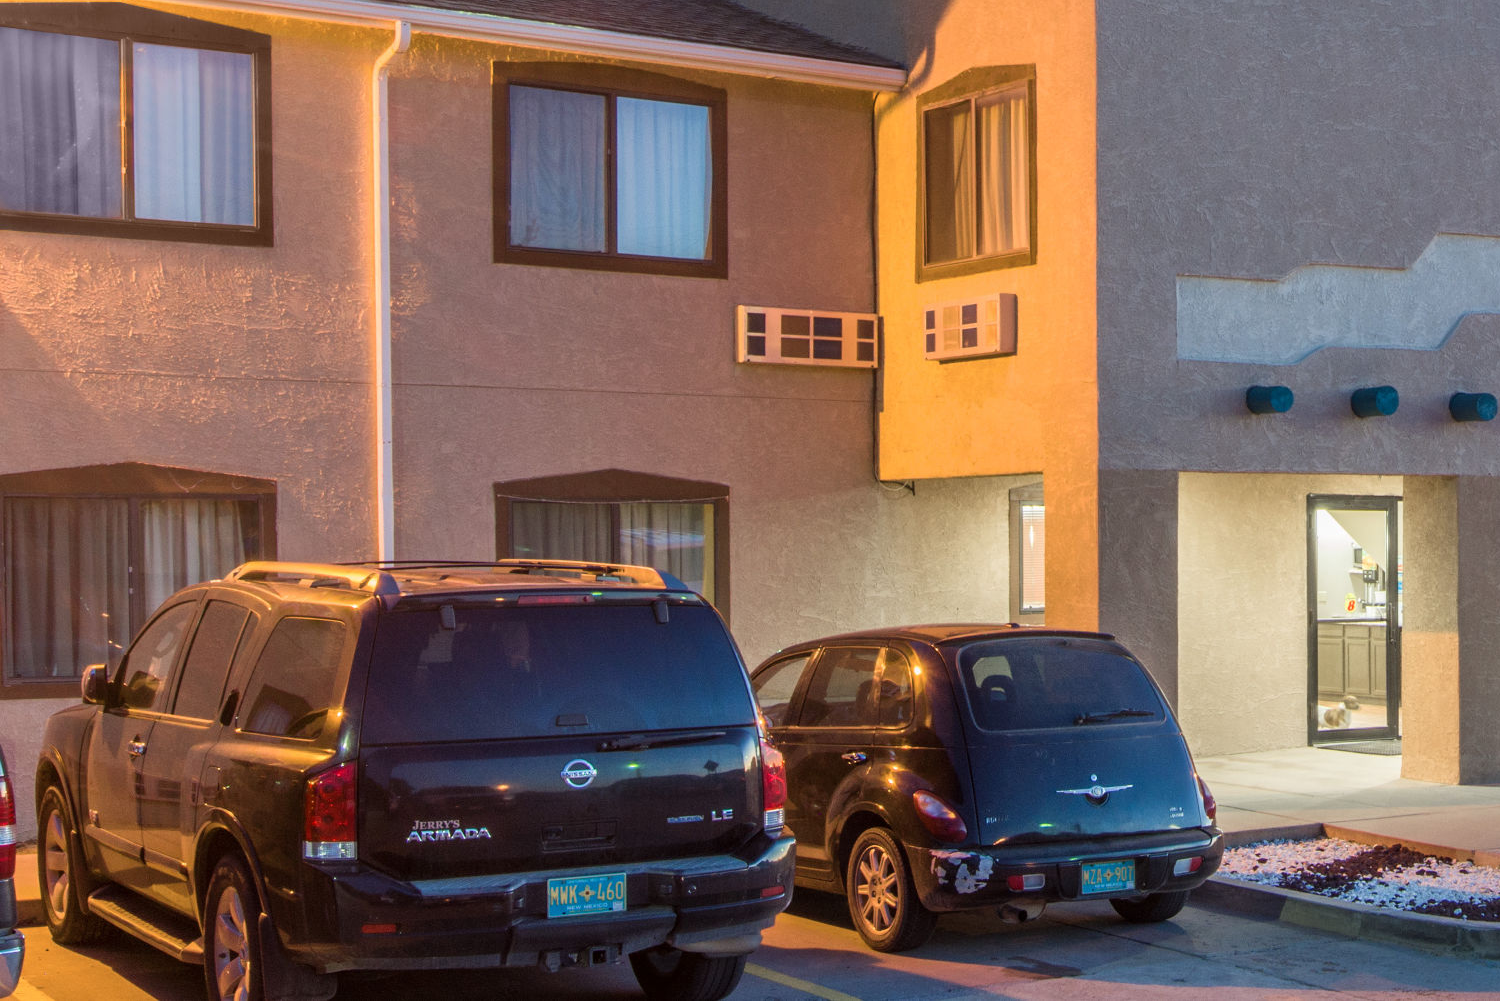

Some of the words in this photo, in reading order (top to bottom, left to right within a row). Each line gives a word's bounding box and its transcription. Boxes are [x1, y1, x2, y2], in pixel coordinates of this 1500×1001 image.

[711, 809, 733, 821] LE
[412, 819, 460, 830] JERRY'S
[406, 827, 491, 842] ARMADA
[550, 885, 577, 906] MWK
[597, 881, 623, 901] 460
